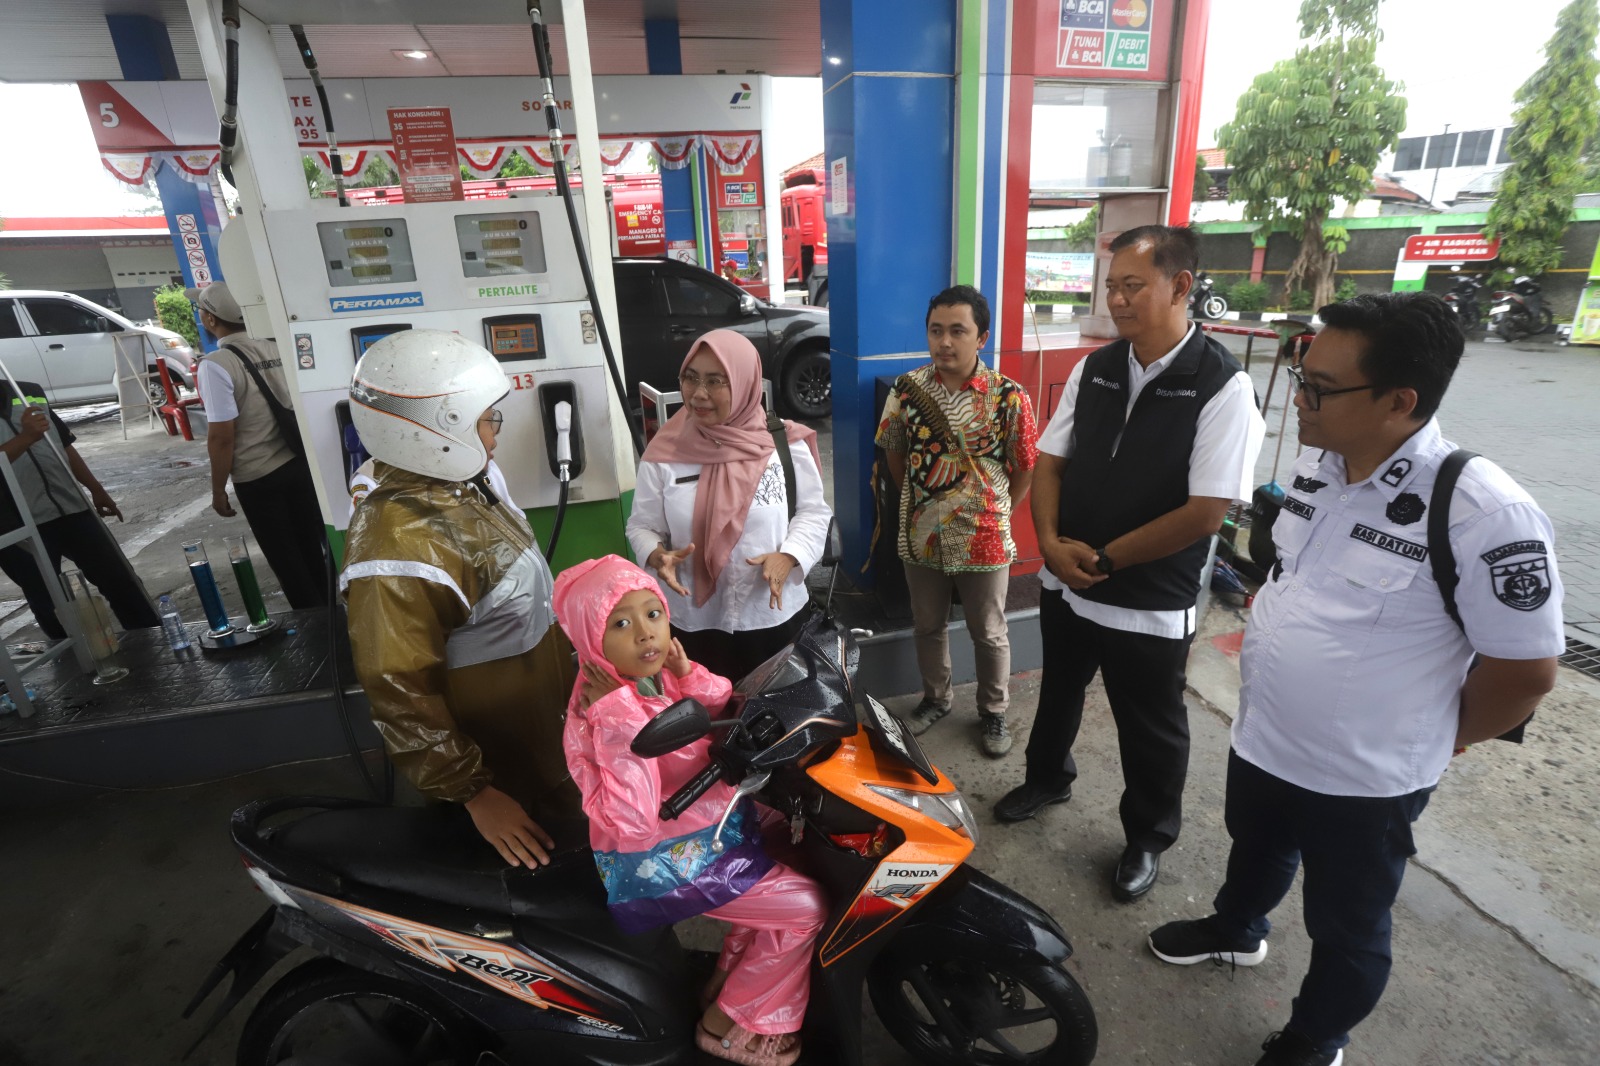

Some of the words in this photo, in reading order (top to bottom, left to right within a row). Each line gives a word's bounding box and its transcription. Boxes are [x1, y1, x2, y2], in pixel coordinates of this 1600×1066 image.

[1078, 0, 1104, 14] BCA
[1112, 8, 1146, 17] MasterCard
[1074, 36, 1100, 48] TUNAI
[1118, 38, 1146, 50] DEBIT
[1082, 51, 1102, 63] BCA
[1126, 53, 1146, 65] BCA
[522, 100, 572, 111] SOAR
[100, 102, 120, 128] 5
[300, 128, 319, 140] 95
[519, 220, 527, 230] 0
[384, 227, 393, 237] 0
[478, 285, 538, 297] PERTALITE
[332, 296, 422, 310] PERTAMAX
[512, 374, 534, 391] 13
[1353, 526, 1376, 542] KASI
[1377, 535, 1424, 558] DATUN
[887, 869, 939, 878] HONDA
